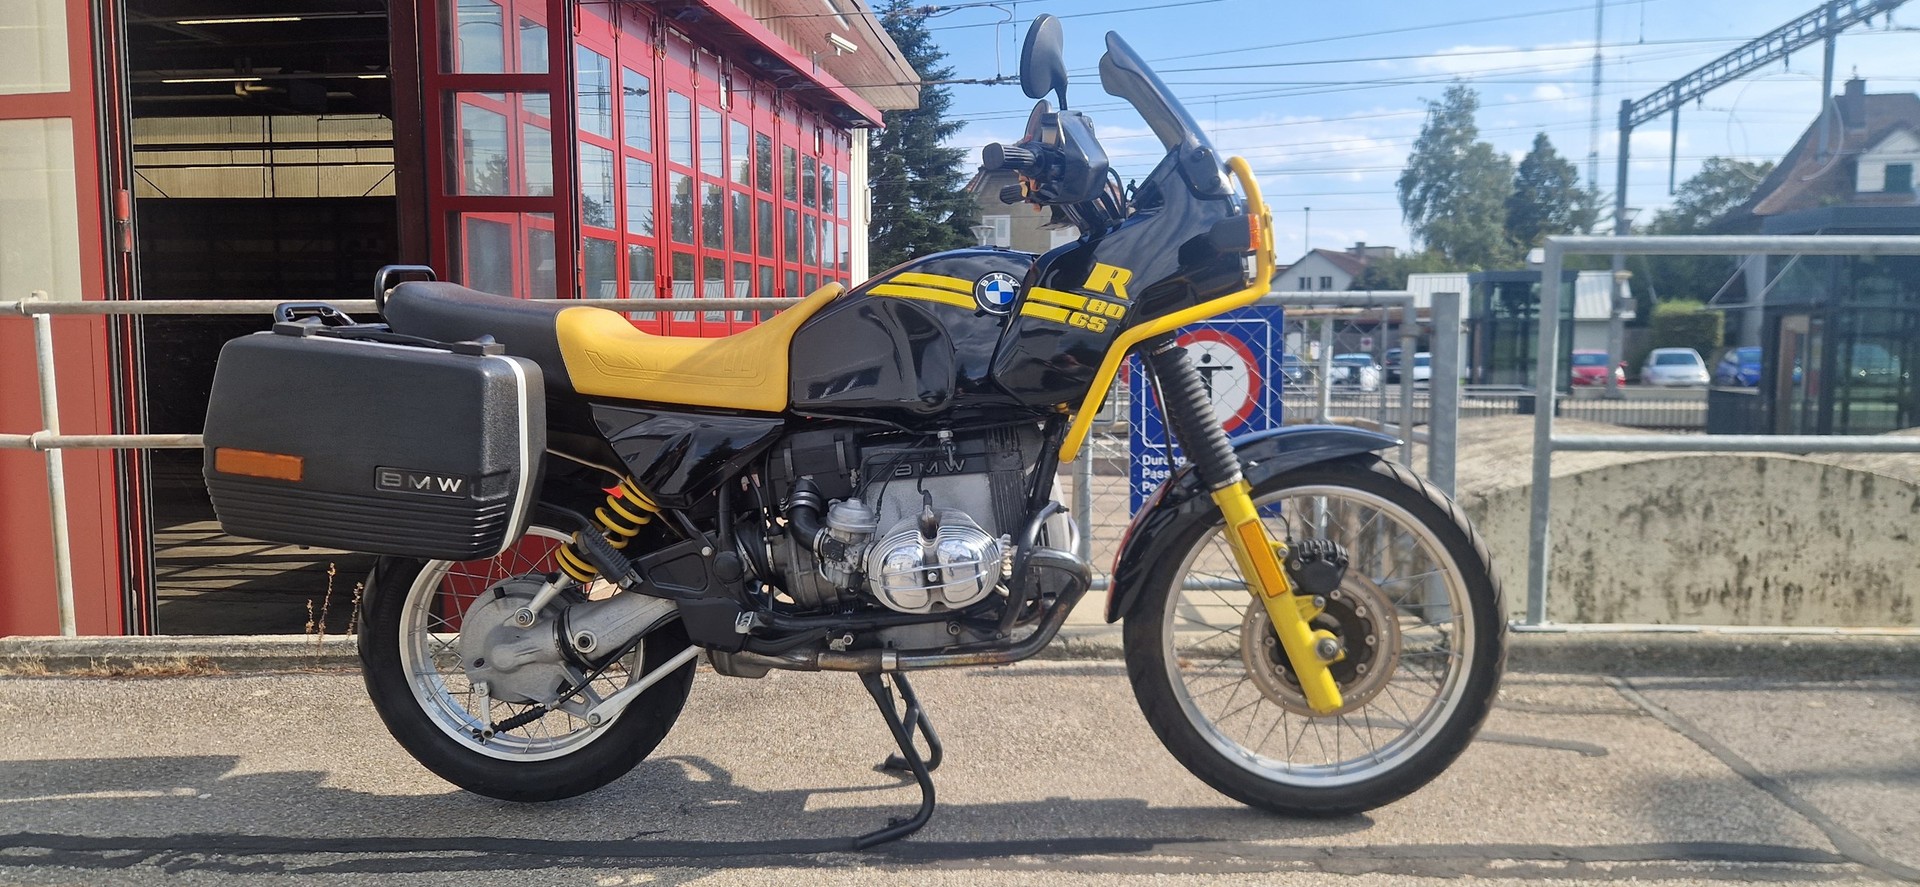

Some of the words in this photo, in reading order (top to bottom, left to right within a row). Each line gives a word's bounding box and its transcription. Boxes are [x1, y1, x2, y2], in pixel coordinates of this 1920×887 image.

[981, 274, 1019, 286] BMW
[1083, 262, 1132, 299] R
[1086, 299, 1125, 319] 80
[1069, 311, 1107, 333] GS
[894, 460, 965, 476] BMW
[1142, 468, 1171, 479] Pass
[382, 472, 462, 492] BMW
